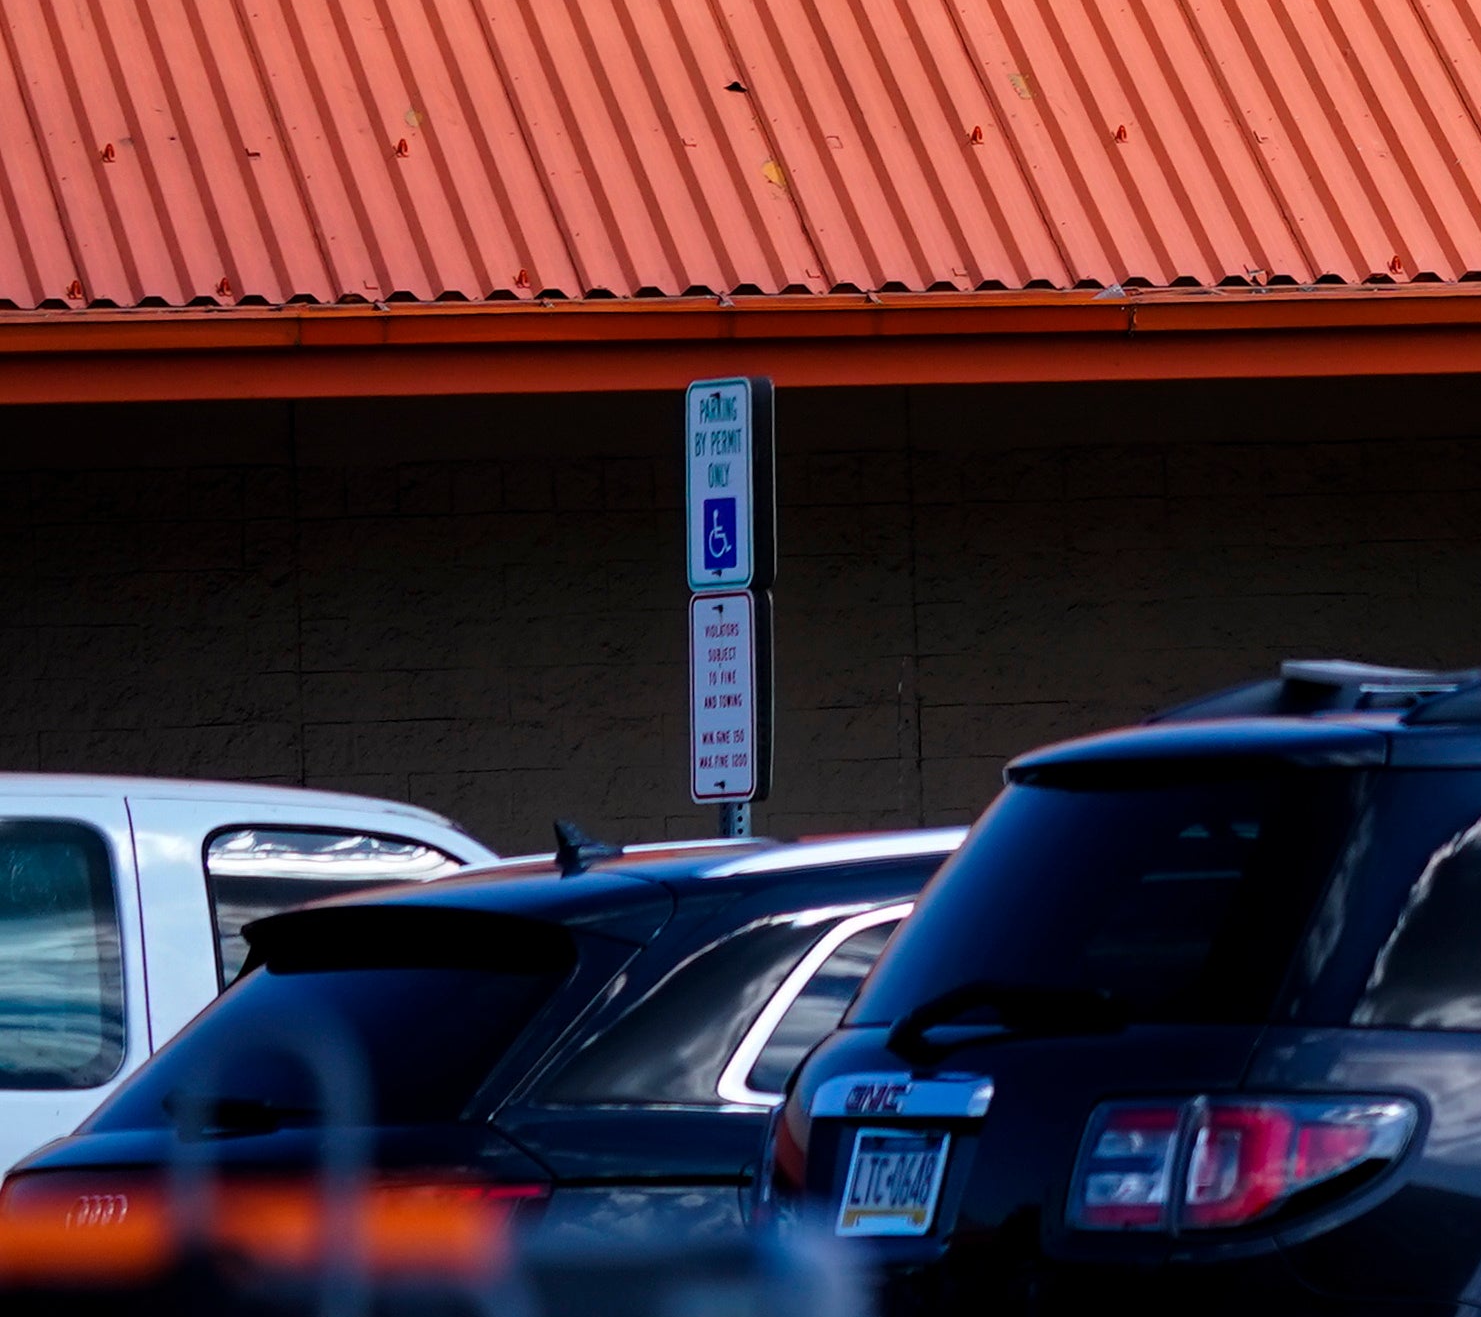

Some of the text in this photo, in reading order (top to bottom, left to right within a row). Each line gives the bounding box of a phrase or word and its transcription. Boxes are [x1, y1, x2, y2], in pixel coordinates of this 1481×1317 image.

[700, 396, 738, 425] PARKING
[694, 428, 742, 457] BY PERMIT
[707, 462, 731, 489] ONLY
[845, 1082, 912, 1114] GMC
